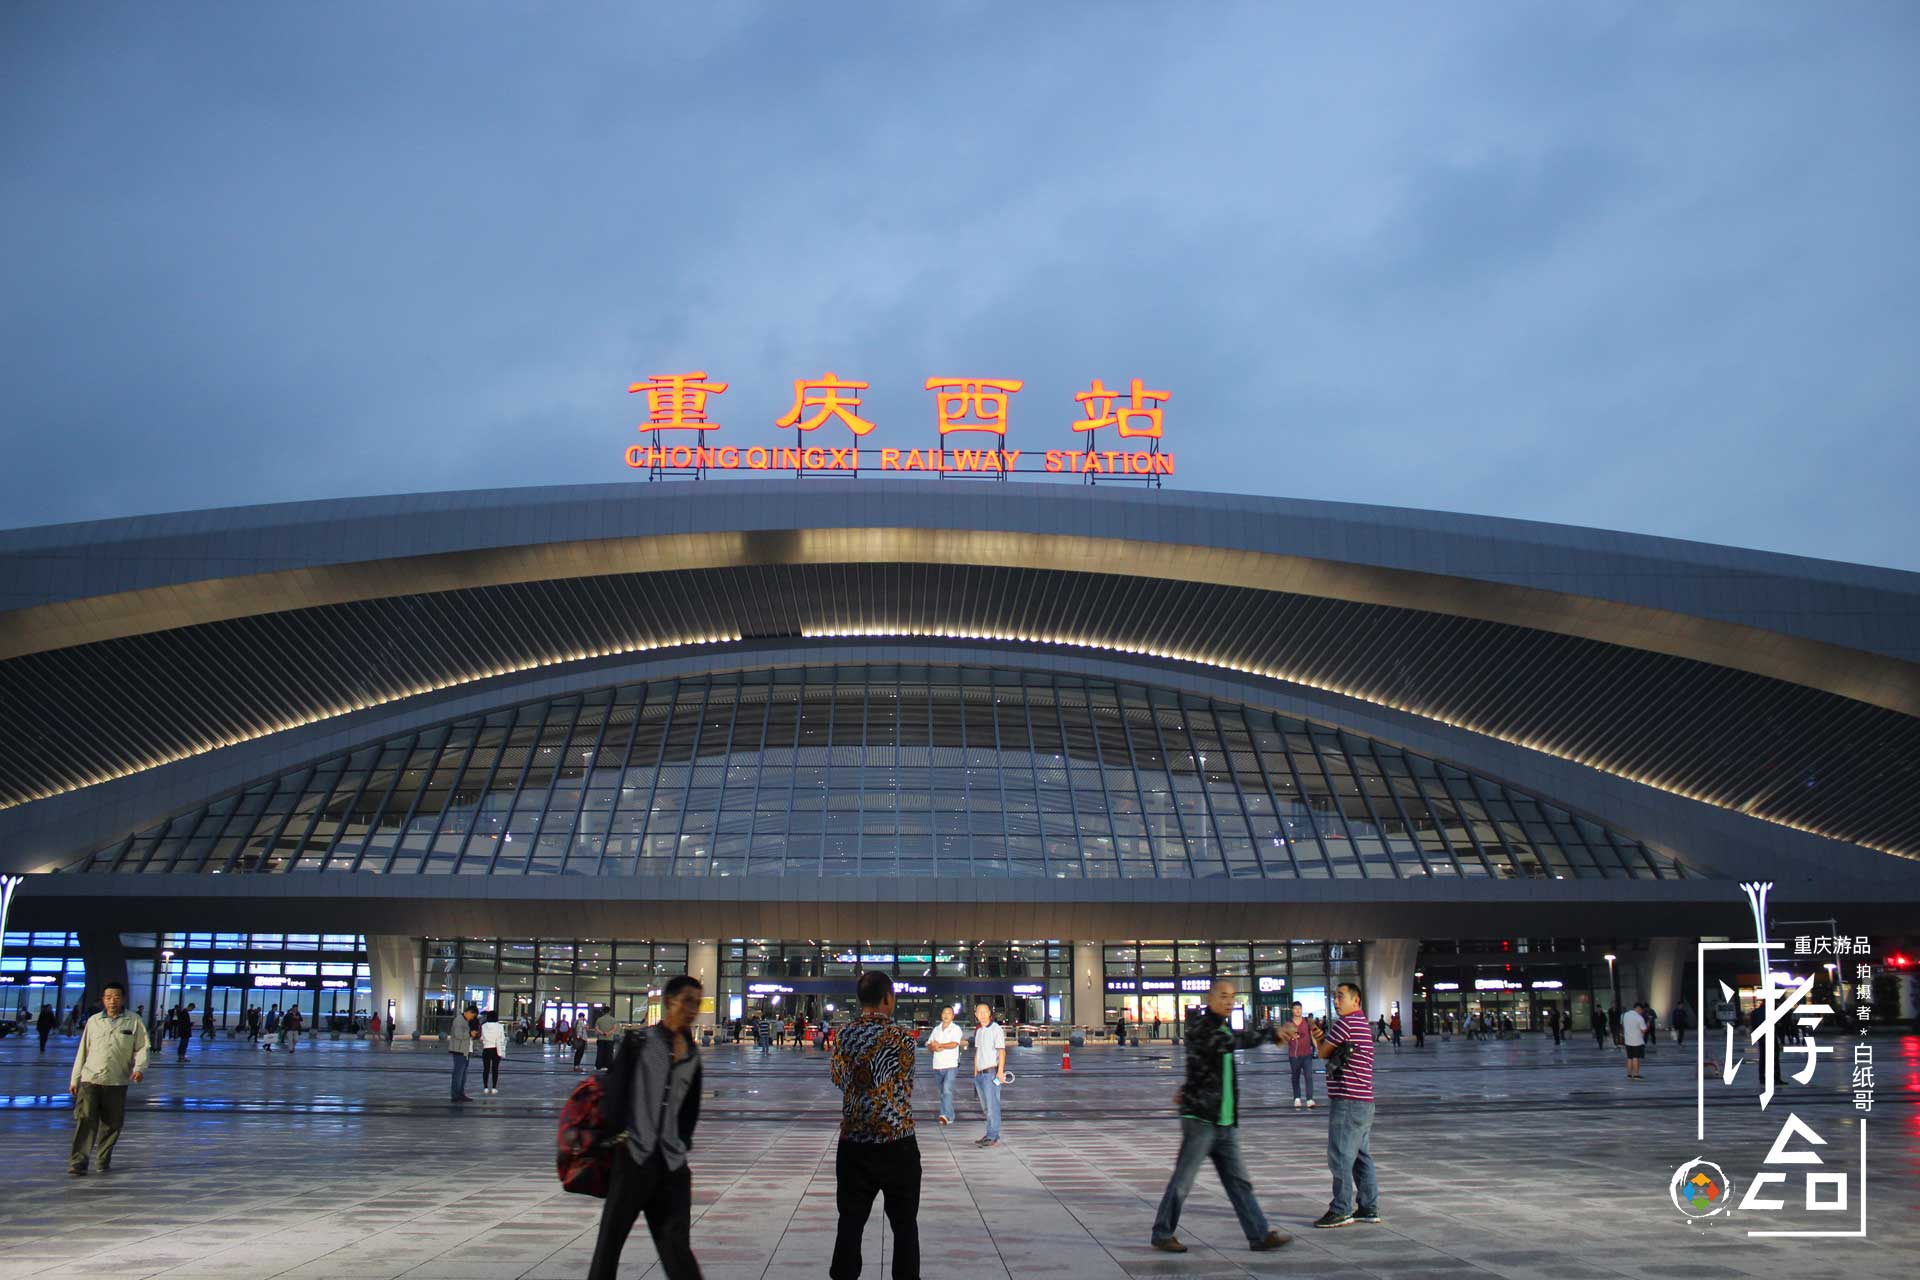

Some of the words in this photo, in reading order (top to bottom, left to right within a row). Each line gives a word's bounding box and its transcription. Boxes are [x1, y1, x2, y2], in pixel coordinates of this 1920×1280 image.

[628, 371, 1172, 438] 重庆西站
[880, 447, 1021, 473] RAILWAY
[1044, 449, 1175, 476] STATION
